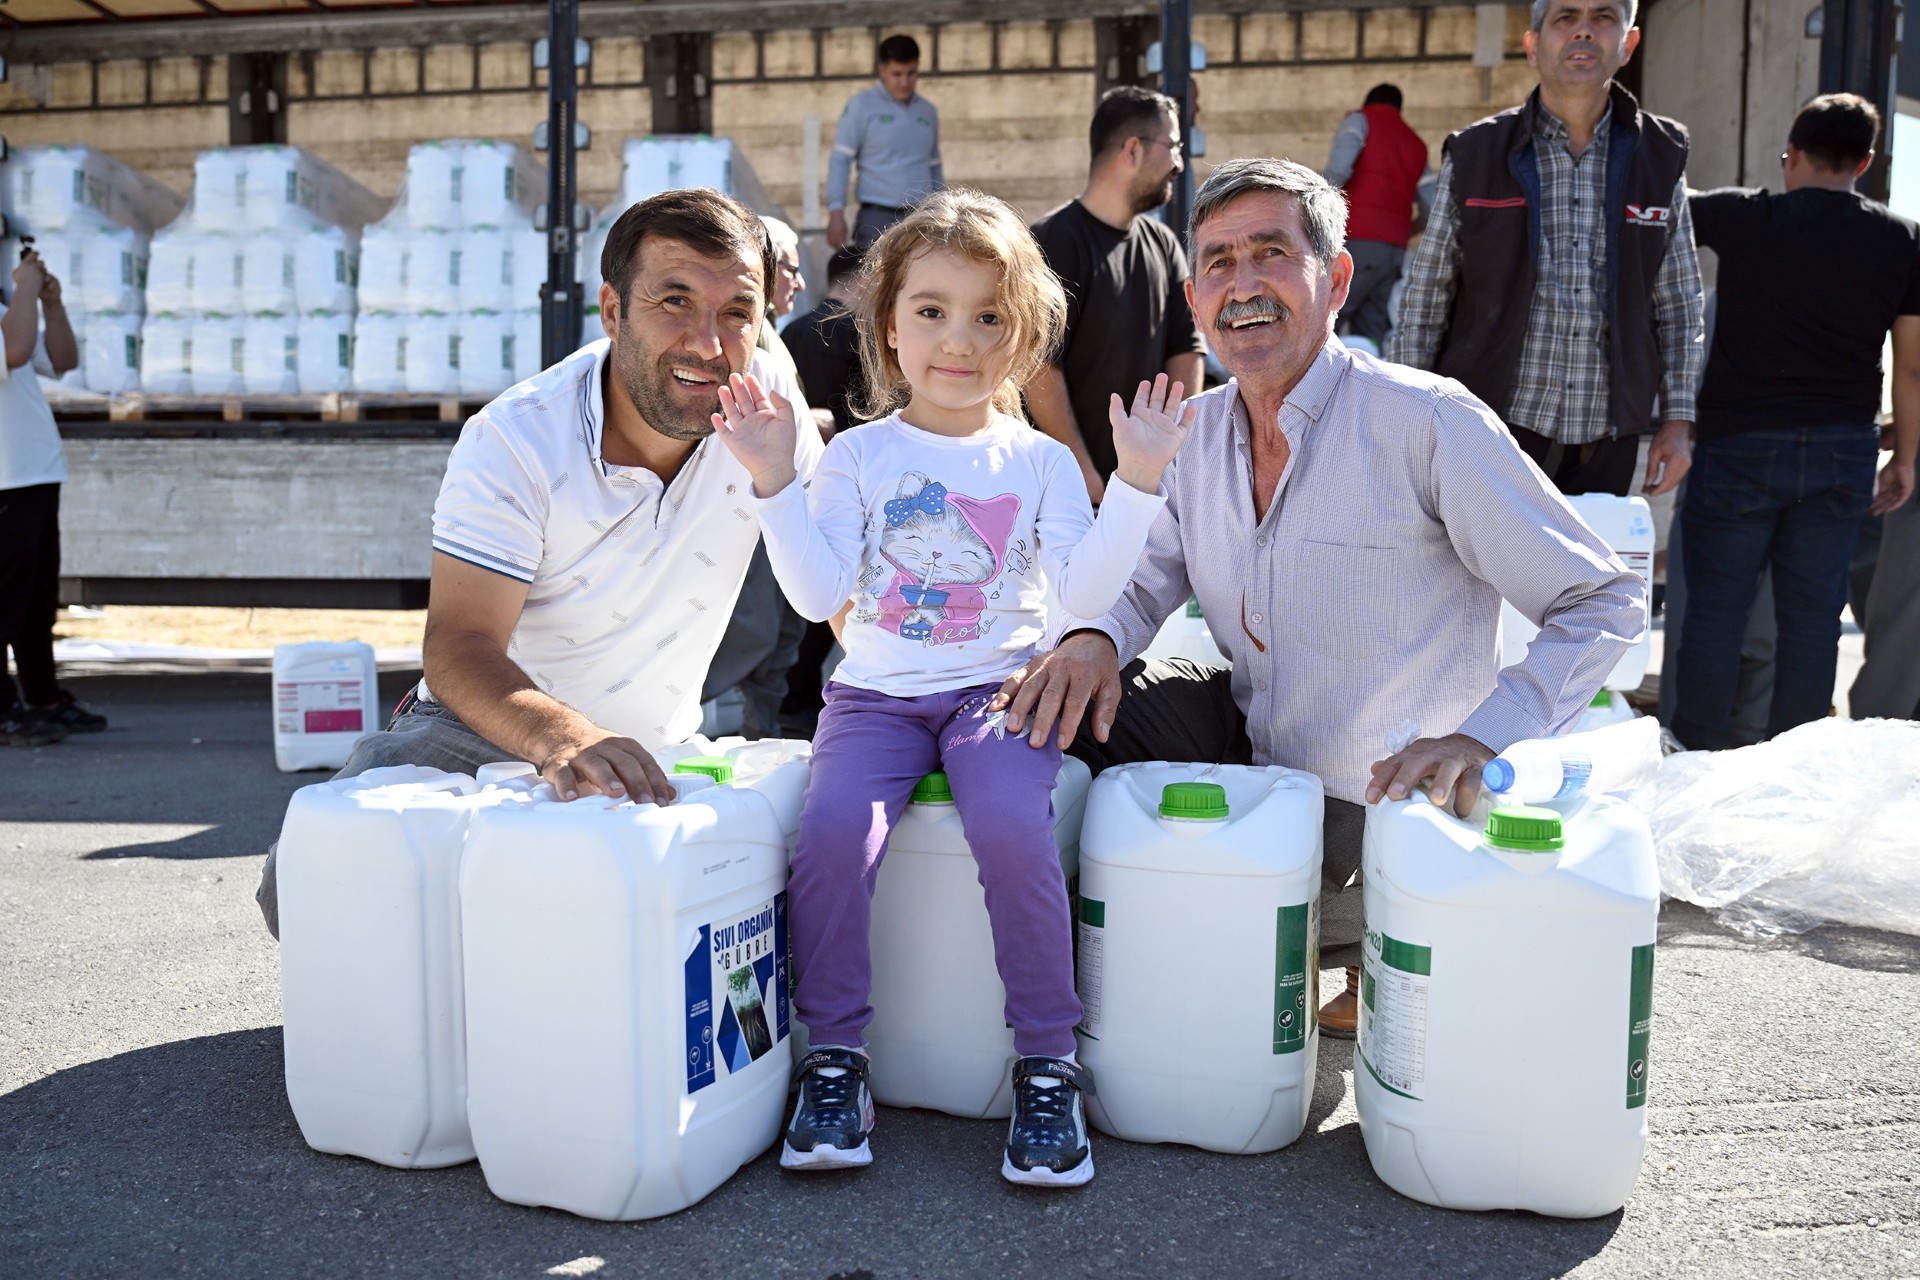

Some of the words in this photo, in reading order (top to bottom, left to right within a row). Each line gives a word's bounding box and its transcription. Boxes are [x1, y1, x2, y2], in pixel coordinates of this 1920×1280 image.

[922, 615, 999, 649] meow
[713, 925, 735, 953] SIVI
[737, 904, 773, 944] ORGANİK
[724, 934, 768, 970] GÜBRE
[804, 1054, 832, 1068] FROZEN
[1048, 1062, 1076, 1078] FROZEN
